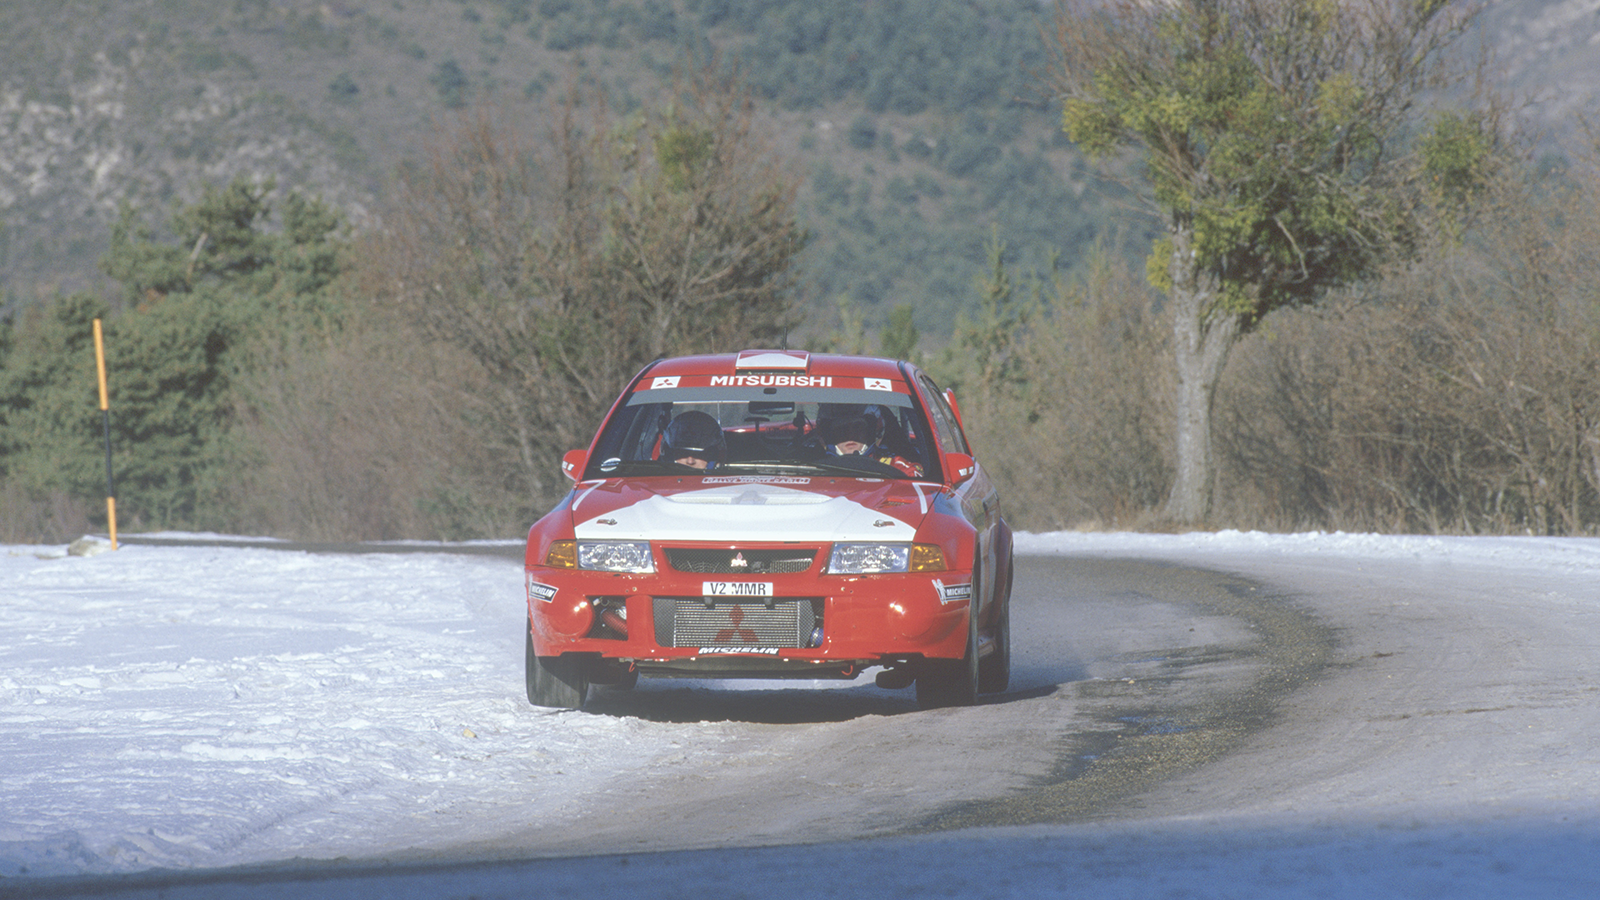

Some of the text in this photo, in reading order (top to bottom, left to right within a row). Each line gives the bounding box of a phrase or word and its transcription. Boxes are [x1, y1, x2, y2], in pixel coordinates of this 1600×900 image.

[710, 375, 832, 387] MITSUBISHI
[710, 582, 766, 596] V2 MMR
[698, 647, 779, 655] MICHELIN
